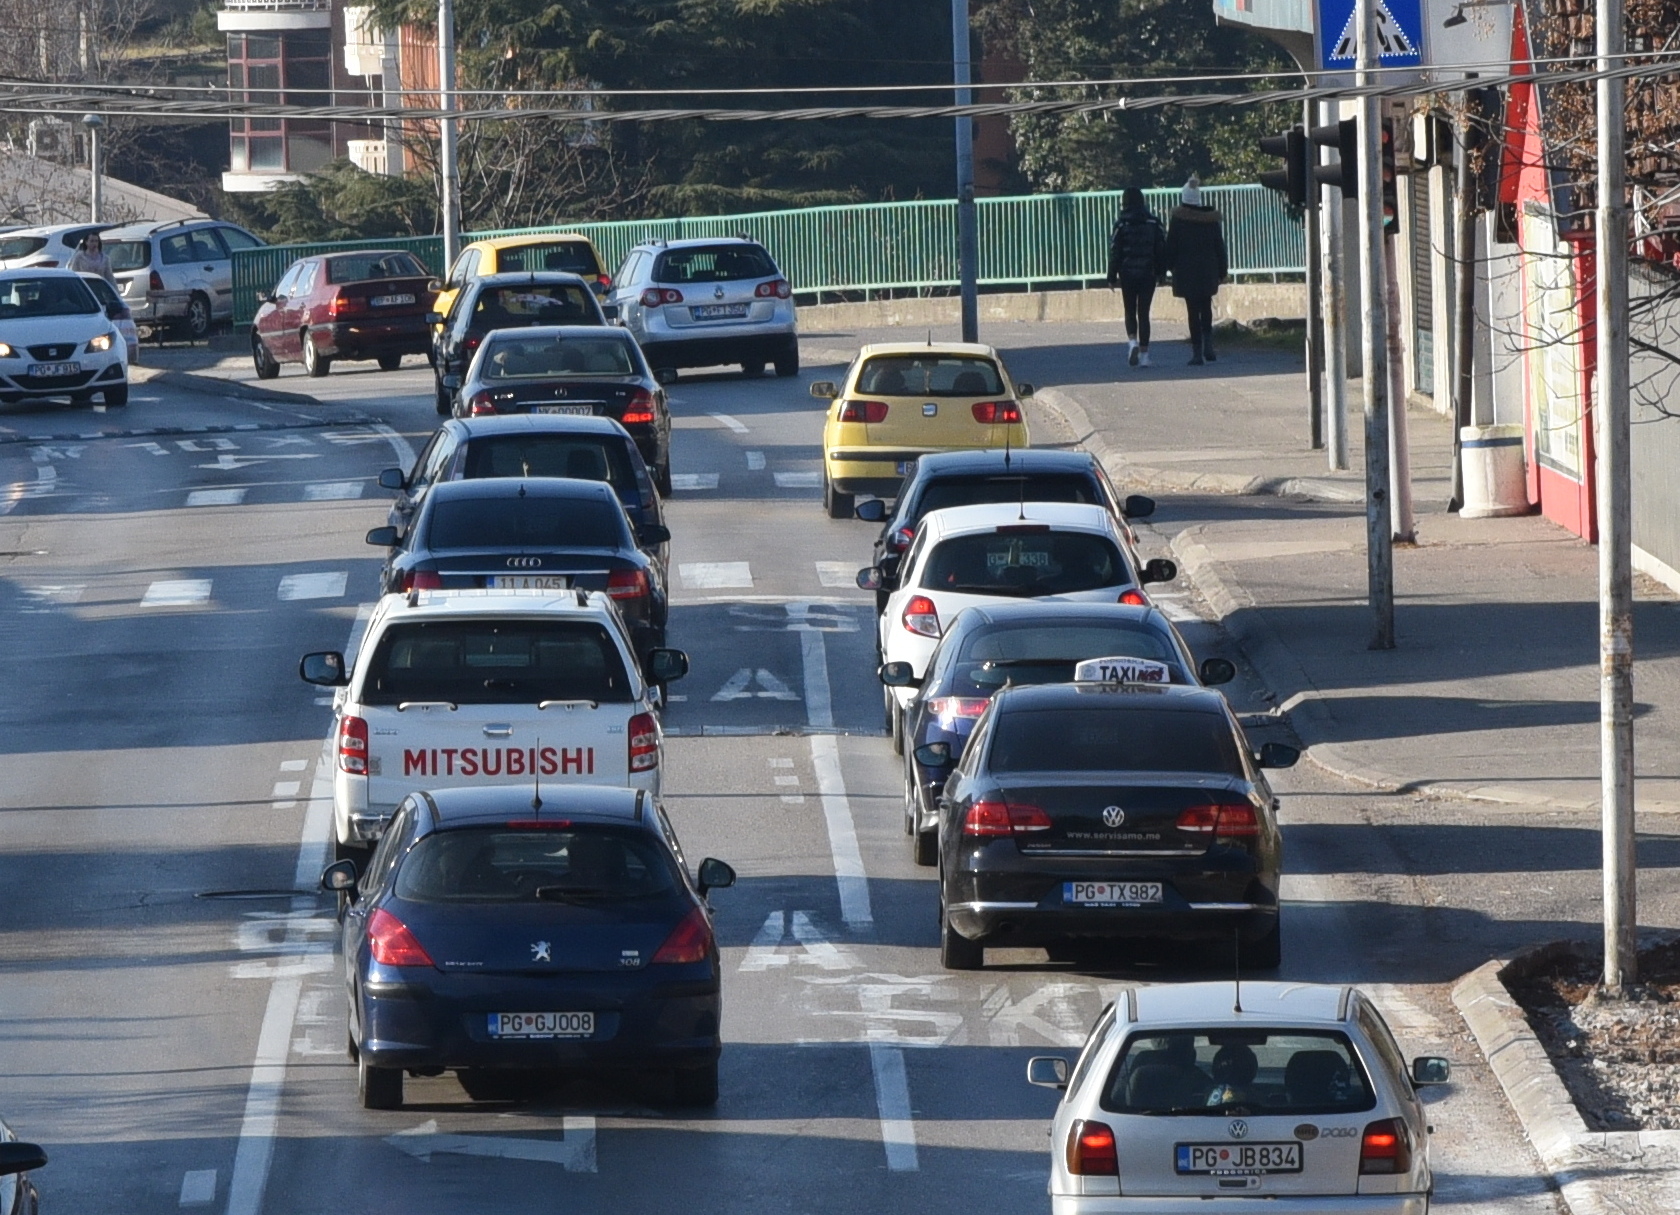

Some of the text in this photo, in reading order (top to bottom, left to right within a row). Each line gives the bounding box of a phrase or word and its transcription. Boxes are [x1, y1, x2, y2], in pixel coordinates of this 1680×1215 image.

[1100, 665, 1136, 681] TAXI
[403, 747, 594, 776] MITSUBISHI
[1075, 884, 1096, 900] PG
[1109, 884, 1160, 901] TX982
[500, 1014, 523, 1032] PG
[534, 1014, 592, 1032] GJ008
[1192, 1147, 1296, 1168] PG JB834
